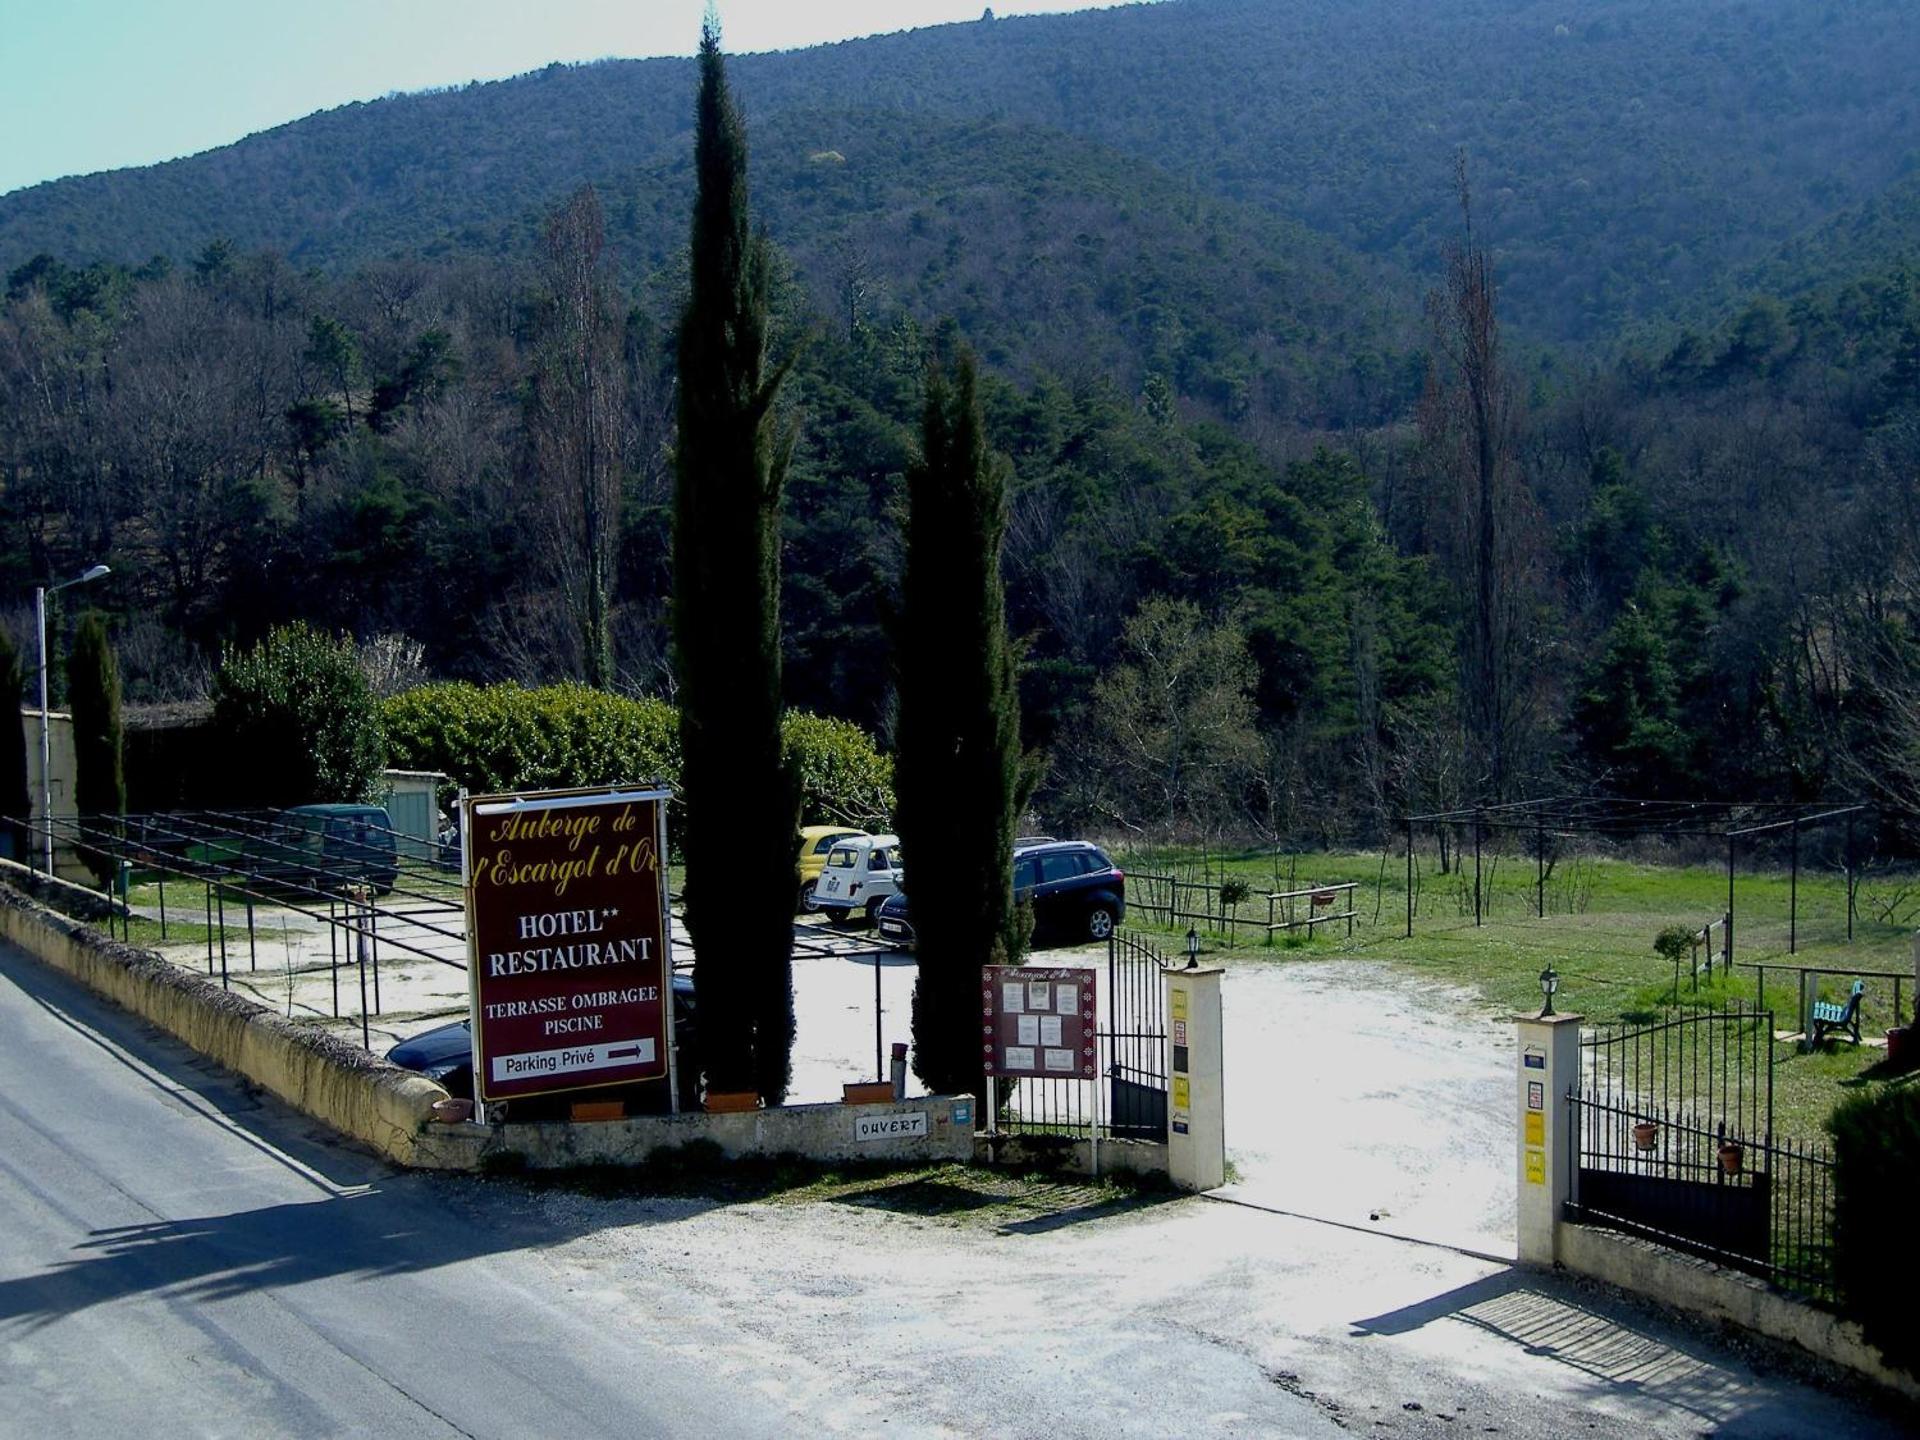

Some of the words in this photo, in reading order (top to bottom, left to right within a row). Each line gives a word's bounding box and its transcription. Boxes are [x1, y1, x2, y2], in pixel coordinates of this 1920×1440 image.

[490, 808, 601, 852] Auberge
[612, 804, 637, 832] de
[605, 837, 656, 876] d'Or
[488, 937, 653, 977] RESTAURANT
[485, 996, 567, 1019] TERRASSE
[571, 986, 658, 1010] OMBRAGEE
[544, 1014, 603, 1036] PISCINE
[506, 1055, 556, 1074] Parking
[562, 1048, 595, 1067] Privé
[862, 1120, 920, 1135] OUVERT
